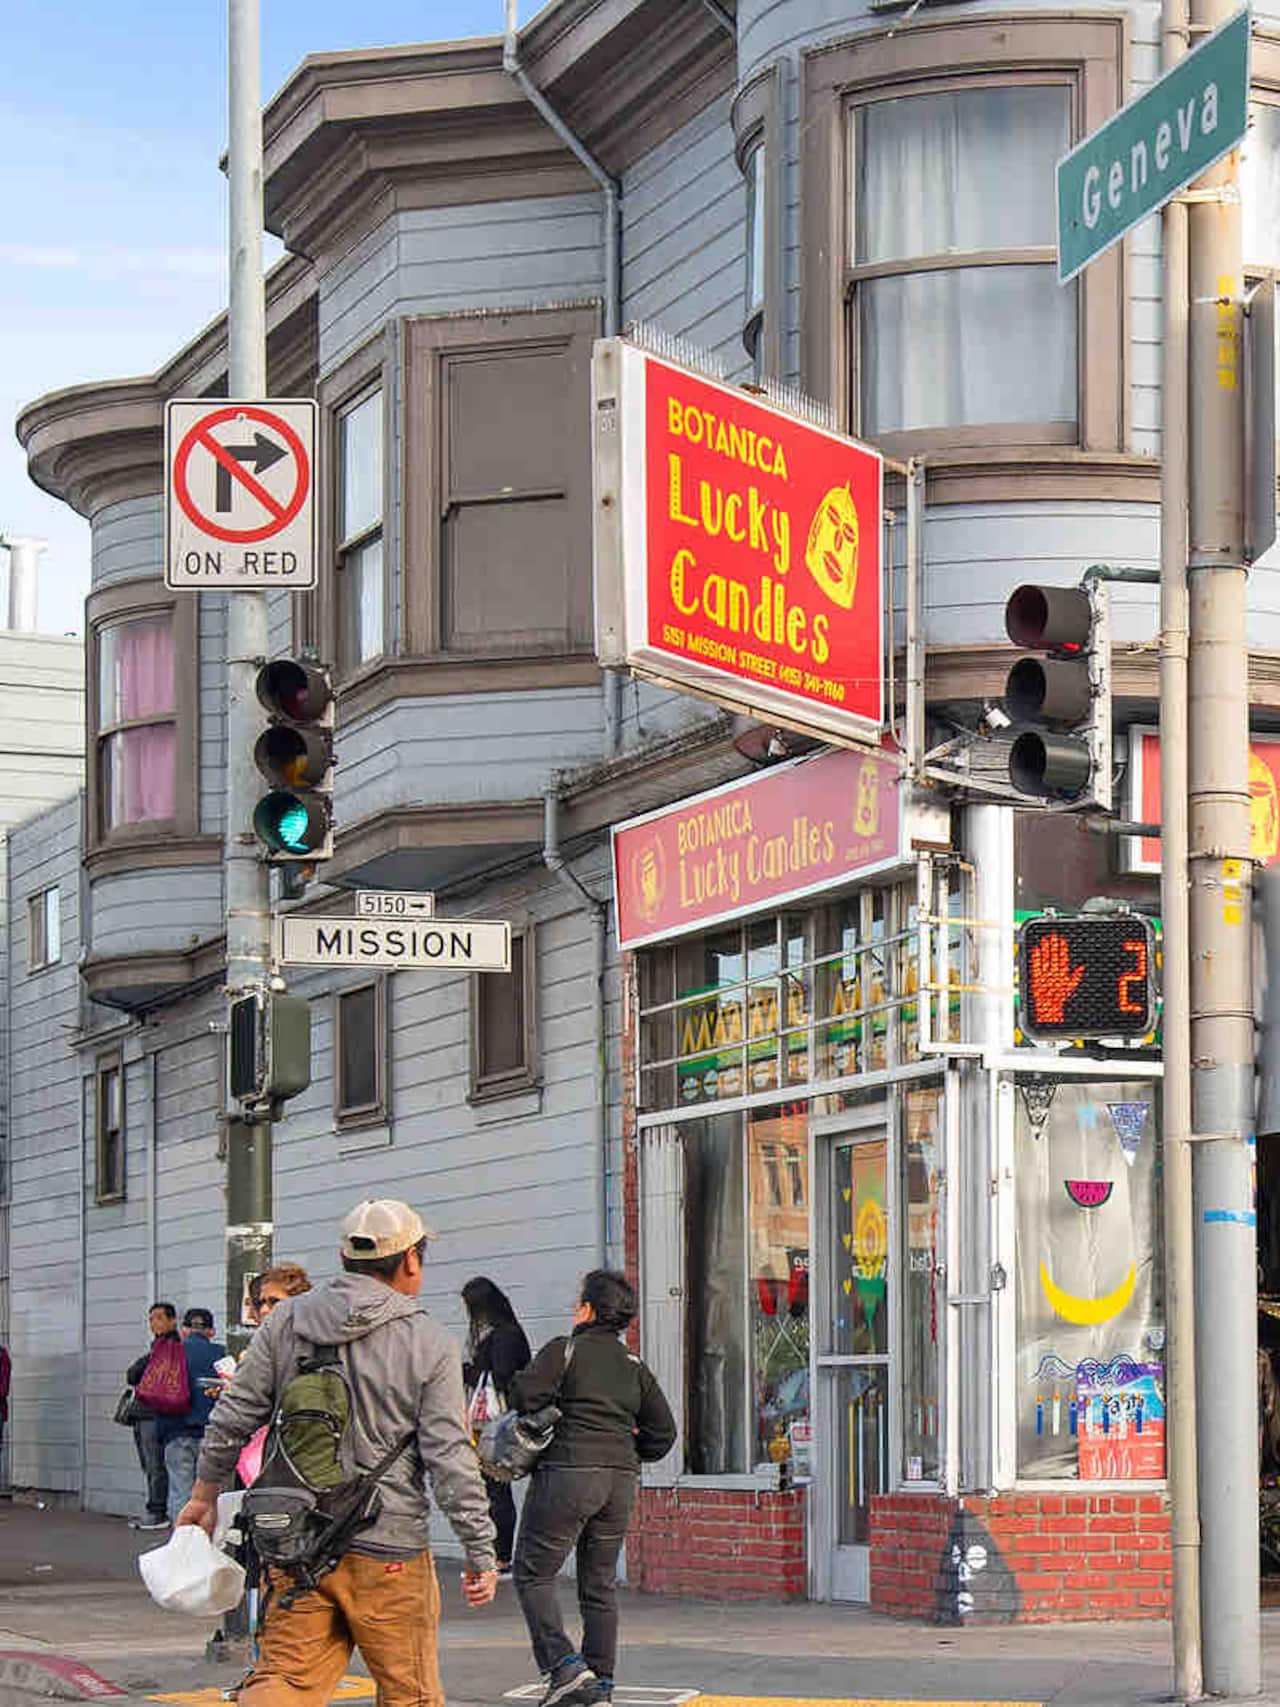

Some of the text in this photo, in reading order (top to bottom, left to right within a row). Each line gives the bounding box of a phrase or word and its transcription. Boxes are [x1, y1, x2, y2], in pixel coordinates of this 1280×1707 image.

[1082, 81, 1218, 229] Geneva
[667, 396, 788, 480] BOTANICA
[668, 453, 790, 575] Lucky
[185, 551, 297, 576] ON RED
[669, 549, 829, 664] Candles
[687, 632, 737, 665] MISSION
[738, 650, 777, 679] STREET
[677, 799, 753, 855] BOTANICA
[679, 815, 834, 908] Lucky Candles
[364, 896, 406, 914] 5150
[316, 928, 472, 959] MISSION
[1119, 941, 1148, 1013] 2
